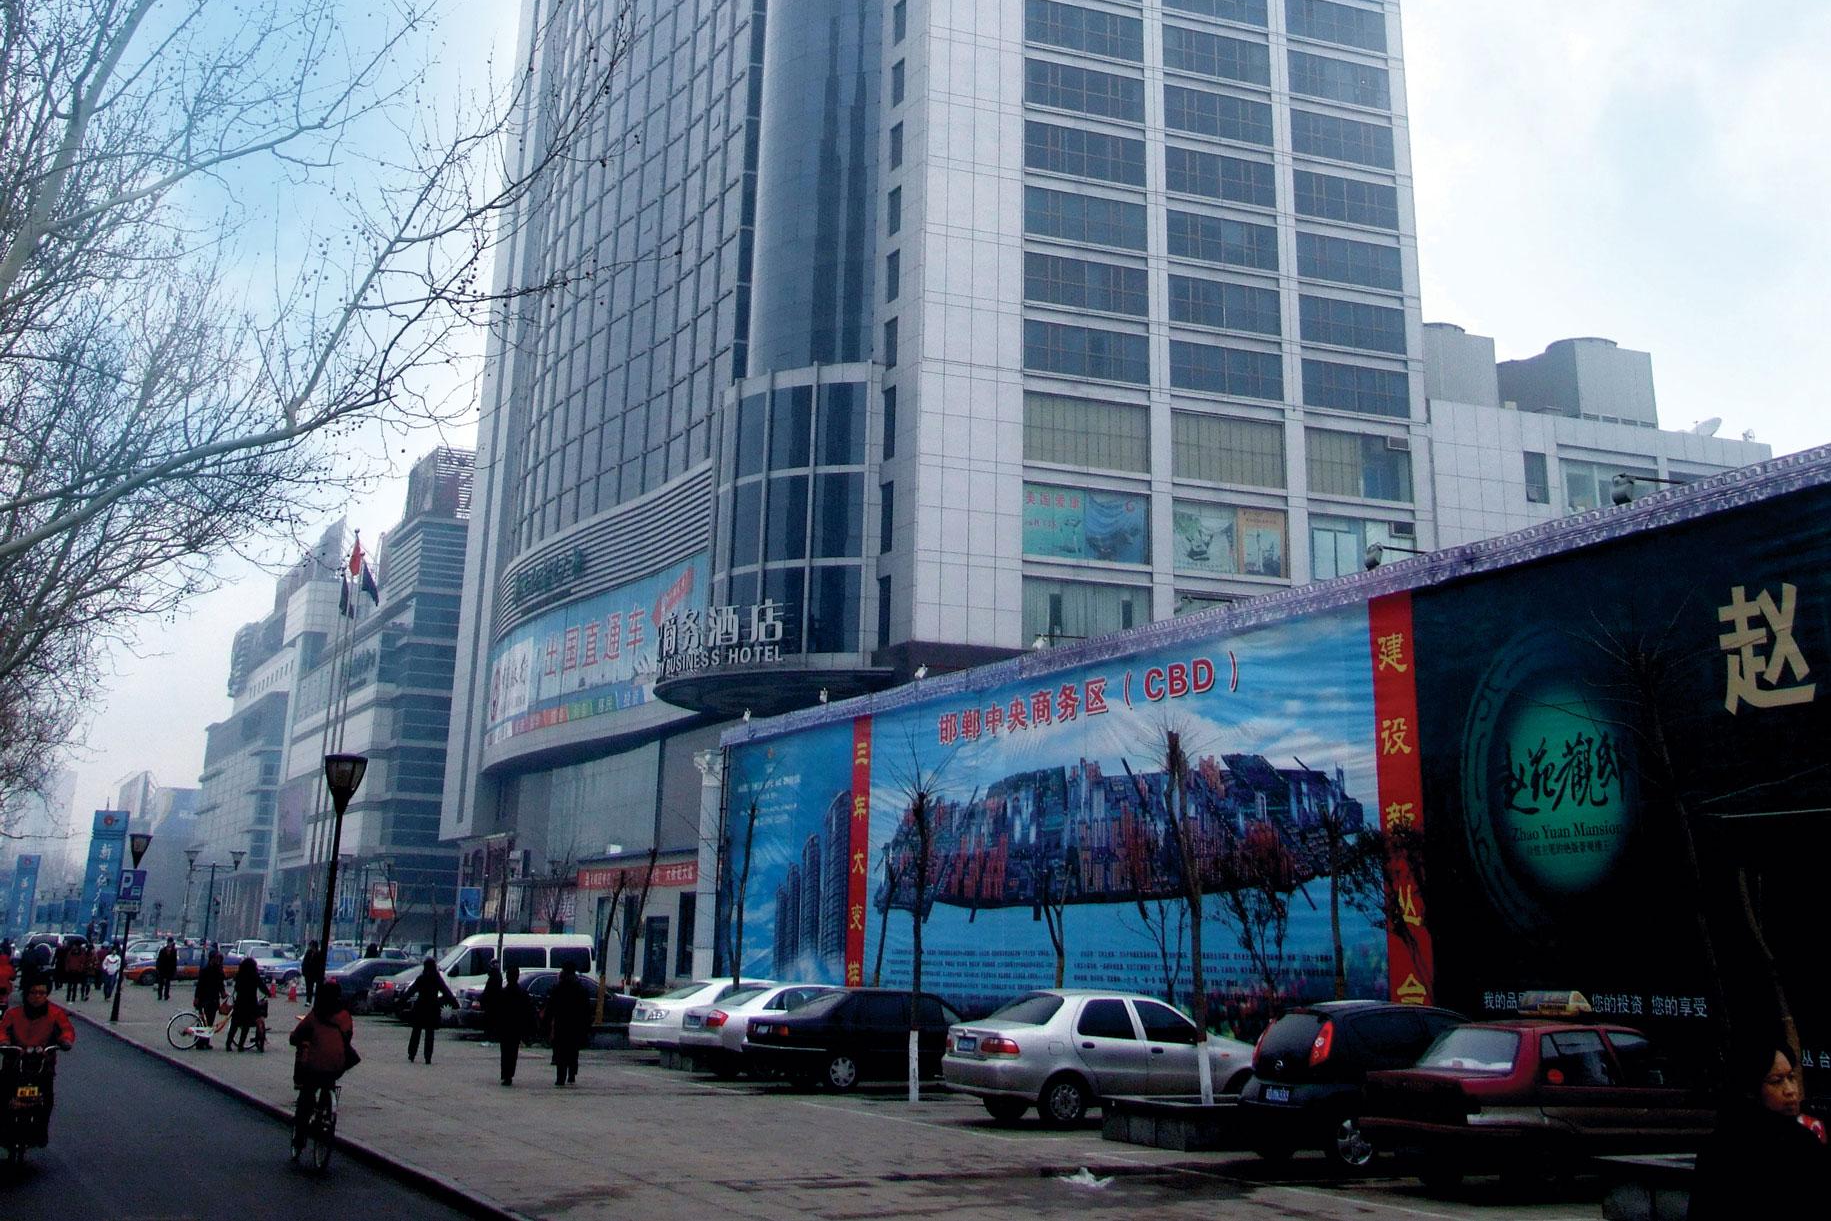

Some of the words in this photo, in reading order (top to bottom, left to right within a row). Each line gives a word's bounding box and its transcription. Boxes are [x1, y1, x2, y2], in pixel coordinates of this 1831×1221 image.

[543, 604, 648, 679] 出国直通车
[1717, 583, 1816, 716] 赵
[666, 649, 721, 673] BUSINESS
[729, 645, 784, 665] HOTEL
[1512, 826, 1539, 842] Zhao
[1541, 824, 1570, 840] Yuan
[1572, 820, 1624, 837] Mansion
[120, 873, 134, 896] P
[1482, 990, 1524, 1011] 我的品
[1591, 993, 1643, 1014] 您的投资
[1651, 994, 1708, 1018] 您的享受
